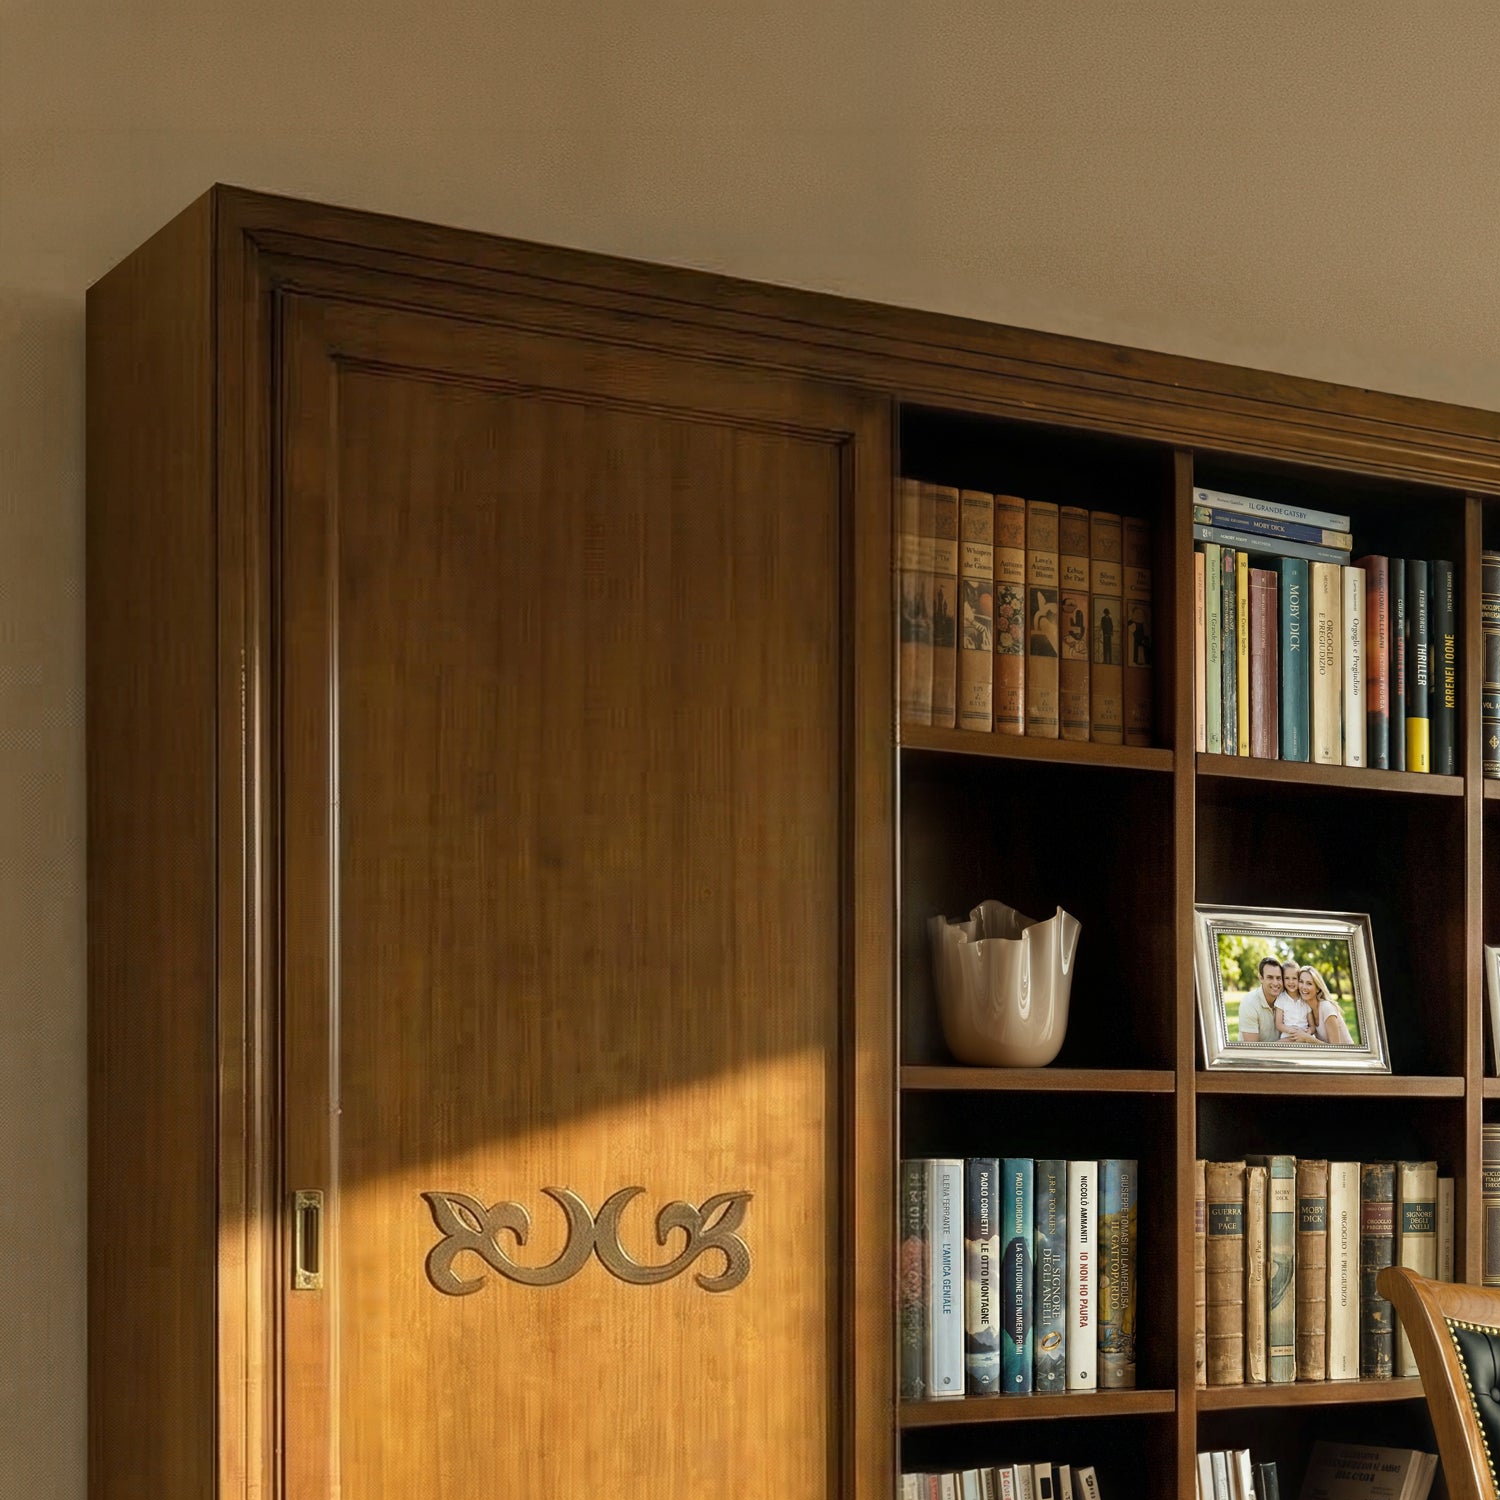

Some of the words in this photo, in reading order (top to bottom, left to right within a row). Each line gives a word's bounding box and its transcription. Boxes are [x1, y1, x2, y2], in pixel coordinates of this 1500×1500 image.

[1248, 502, 1255, 510] IL
[1255, 503, 1283, 515] GRANDE
[1283, 509, 1308, 519] GATSBY
[1253, 521, 1270, 530] MOBY
[1270, 524, 1286, 532] DICK
[1289, 583, 1300, 622] MOBY
[1289, 622, 1300, 652] DICK
[1326, 619, 1334, 666] ORGOGLIO
[1351, 655, 1360, 696] Pregiudizio
[1417, 643, 1427, 686] THRILLER
[1444, 667, 1455, 709] KRRENEI
[942, 1174, 951, 1197] ELENA
[980, 1172, 989, 1196] PAOLO
[1015, 1172, 1023, 1195] PAOLO
[1080, 1175, 1090, 1206] NICCOLÒ
[1120, 1174, 1129, 1212] GIUSEPPE
[942, 1198, 951, 1235] FERRANTE
[980, 1197, 989, 1235] COGNETTI
[1015, 1196, 1023, 1234] GIORDANO
[1048, 1197, 1056, 1235] TOLKIEN
[1080, 1207, 1088, 1243] AMMANITI
[1301, 1206, 1325, 1214] MOBY
[1303, 1214, 1322, 1222] DICK
[1111, 1221, 1120, 1231] IL
[1120, 1214, 1129, 1245] TOMASI
[942, 1243, 951, 1277] L'AMICA
[980, 1243, 989, 1253] LE
[1015, 1243, 1023, 1252] LA
[1052, 1254, 1061, 1265] IL
[1080, 1252, 1088, 1261] IO
[1120, 1247, 1129, 1256] DI
[980, 1255, 989, 1276] OTTO
[1015, 1253, 1023, 1293] SOLITUDINE
[1042, 1248, 1051, 1283] DEGLI
[1080, 1263, 1088, 1282] NON
[1111, 1234, 1120, 1310] GATTOPARDO
[942, 1278, 951, 1314] GENIALE
[1052, 1267, 1061, 1319] SIGNORE
[1080, 1284, 1088, 1296] HO
[1120, 1258, 1129, 1309] LAMPEDUSA
[980, 1278, 989, 1325] MONTAGNE
[1015, 1294, 1023, 1306] DEI
[1042, 1285, 1052, 1326] ANELLI
[1080, 1299, 1088, 1328] PAURA
[1015, 1306, 1023, 1334] NUMERI
[1015, 1335, 1023, 1355] PRIMI
